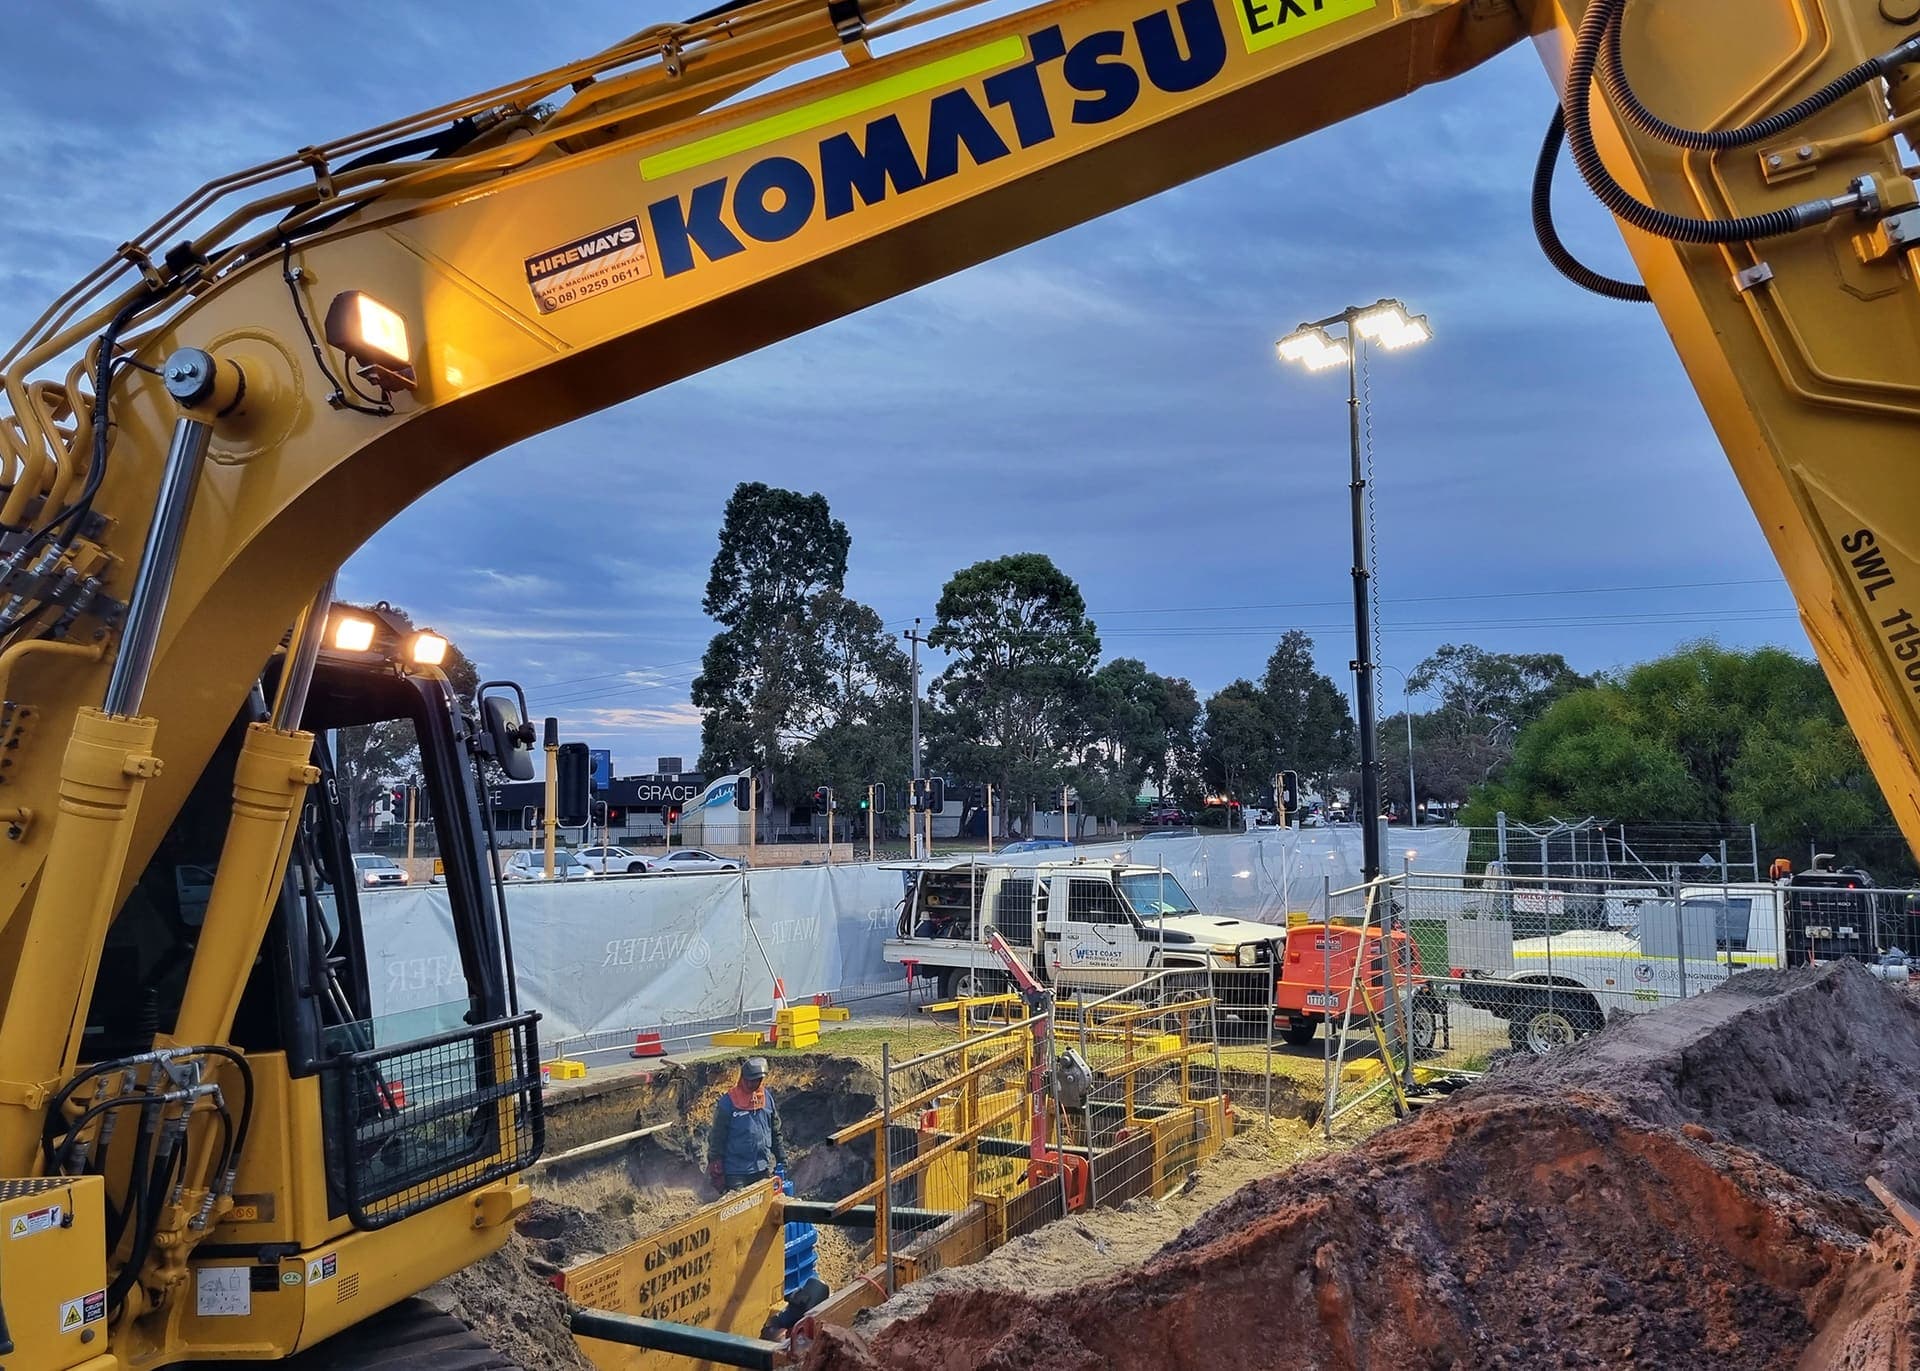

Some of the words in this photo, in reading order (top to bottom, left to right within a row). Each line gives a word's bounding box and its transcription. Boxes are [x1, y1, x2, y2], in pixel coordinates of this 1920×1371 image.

[648, 0, 1227, 279] KOMATSU
[530, 227, 636, 277] HIREWAYS
[611, 254, 645, 271] RENTALS
[579, 278, 609, 296] 9259
[611, 266, 641, 284] 0611
[1841, 529, 1895, 601] SWL
[1076, 949, 1098, 959] WEST
[639, 1251, 712, 1303] SUPPORT
